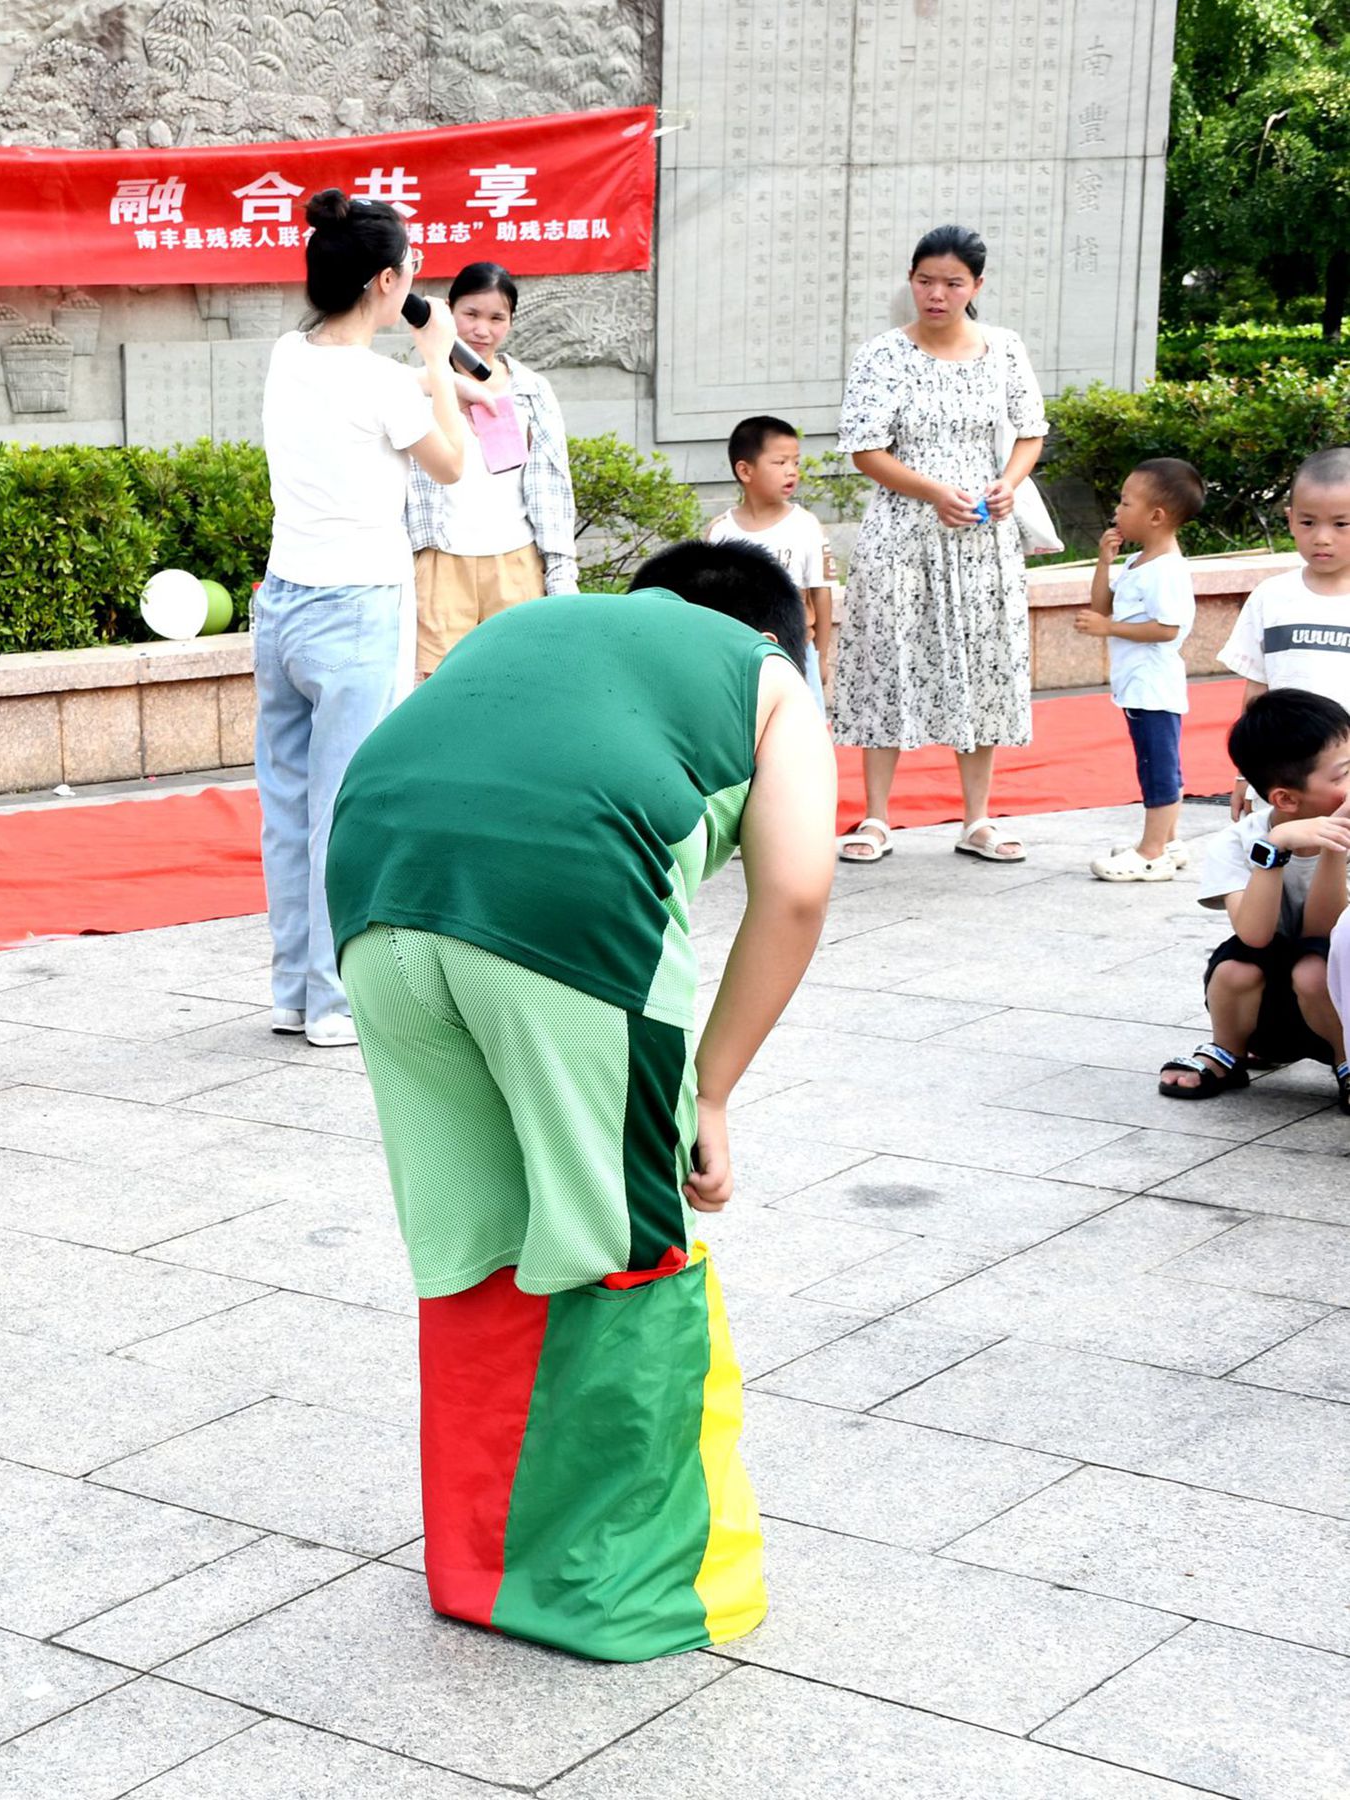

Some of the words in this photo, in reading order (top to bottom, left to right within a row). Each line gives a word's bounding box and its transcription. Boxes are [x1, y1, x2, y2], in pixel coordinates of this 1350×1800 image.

[109, 164, 539, 225] 融合共享
[496, 218, 611, 243] 助残志愿队
